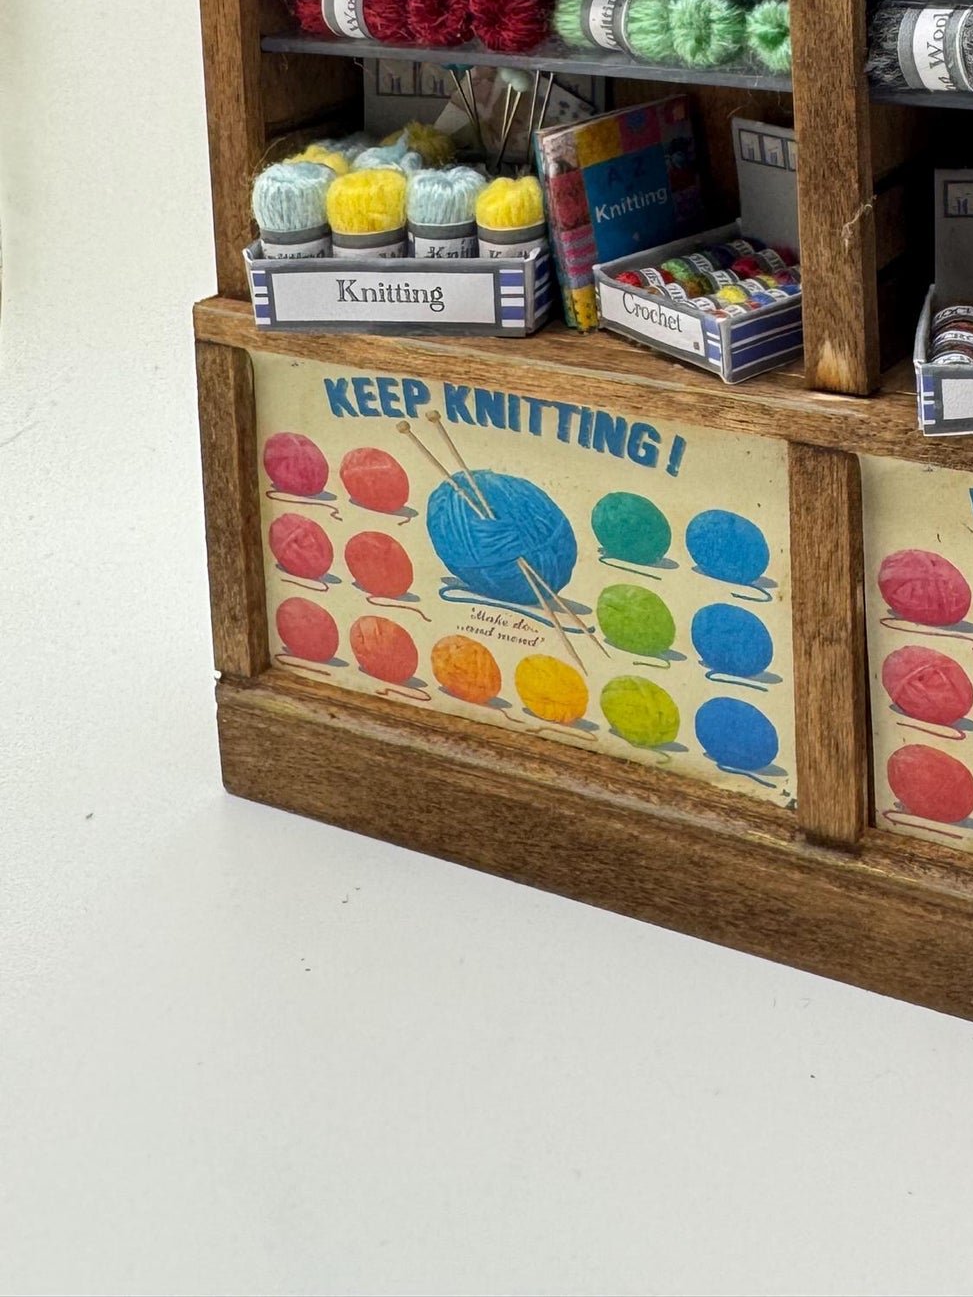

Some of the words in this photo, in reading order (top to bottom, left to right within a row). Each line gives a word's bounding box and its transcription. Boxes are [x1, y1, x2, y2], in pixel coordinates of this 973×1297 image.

[926, 12, 951, 70] Wool
[595, 187, 667, 223] Knitting
[336, 279, 445, 313] Knitting
[623, 292, 682, 333] Crochet
[323, 377, 430, 418] KEEP
